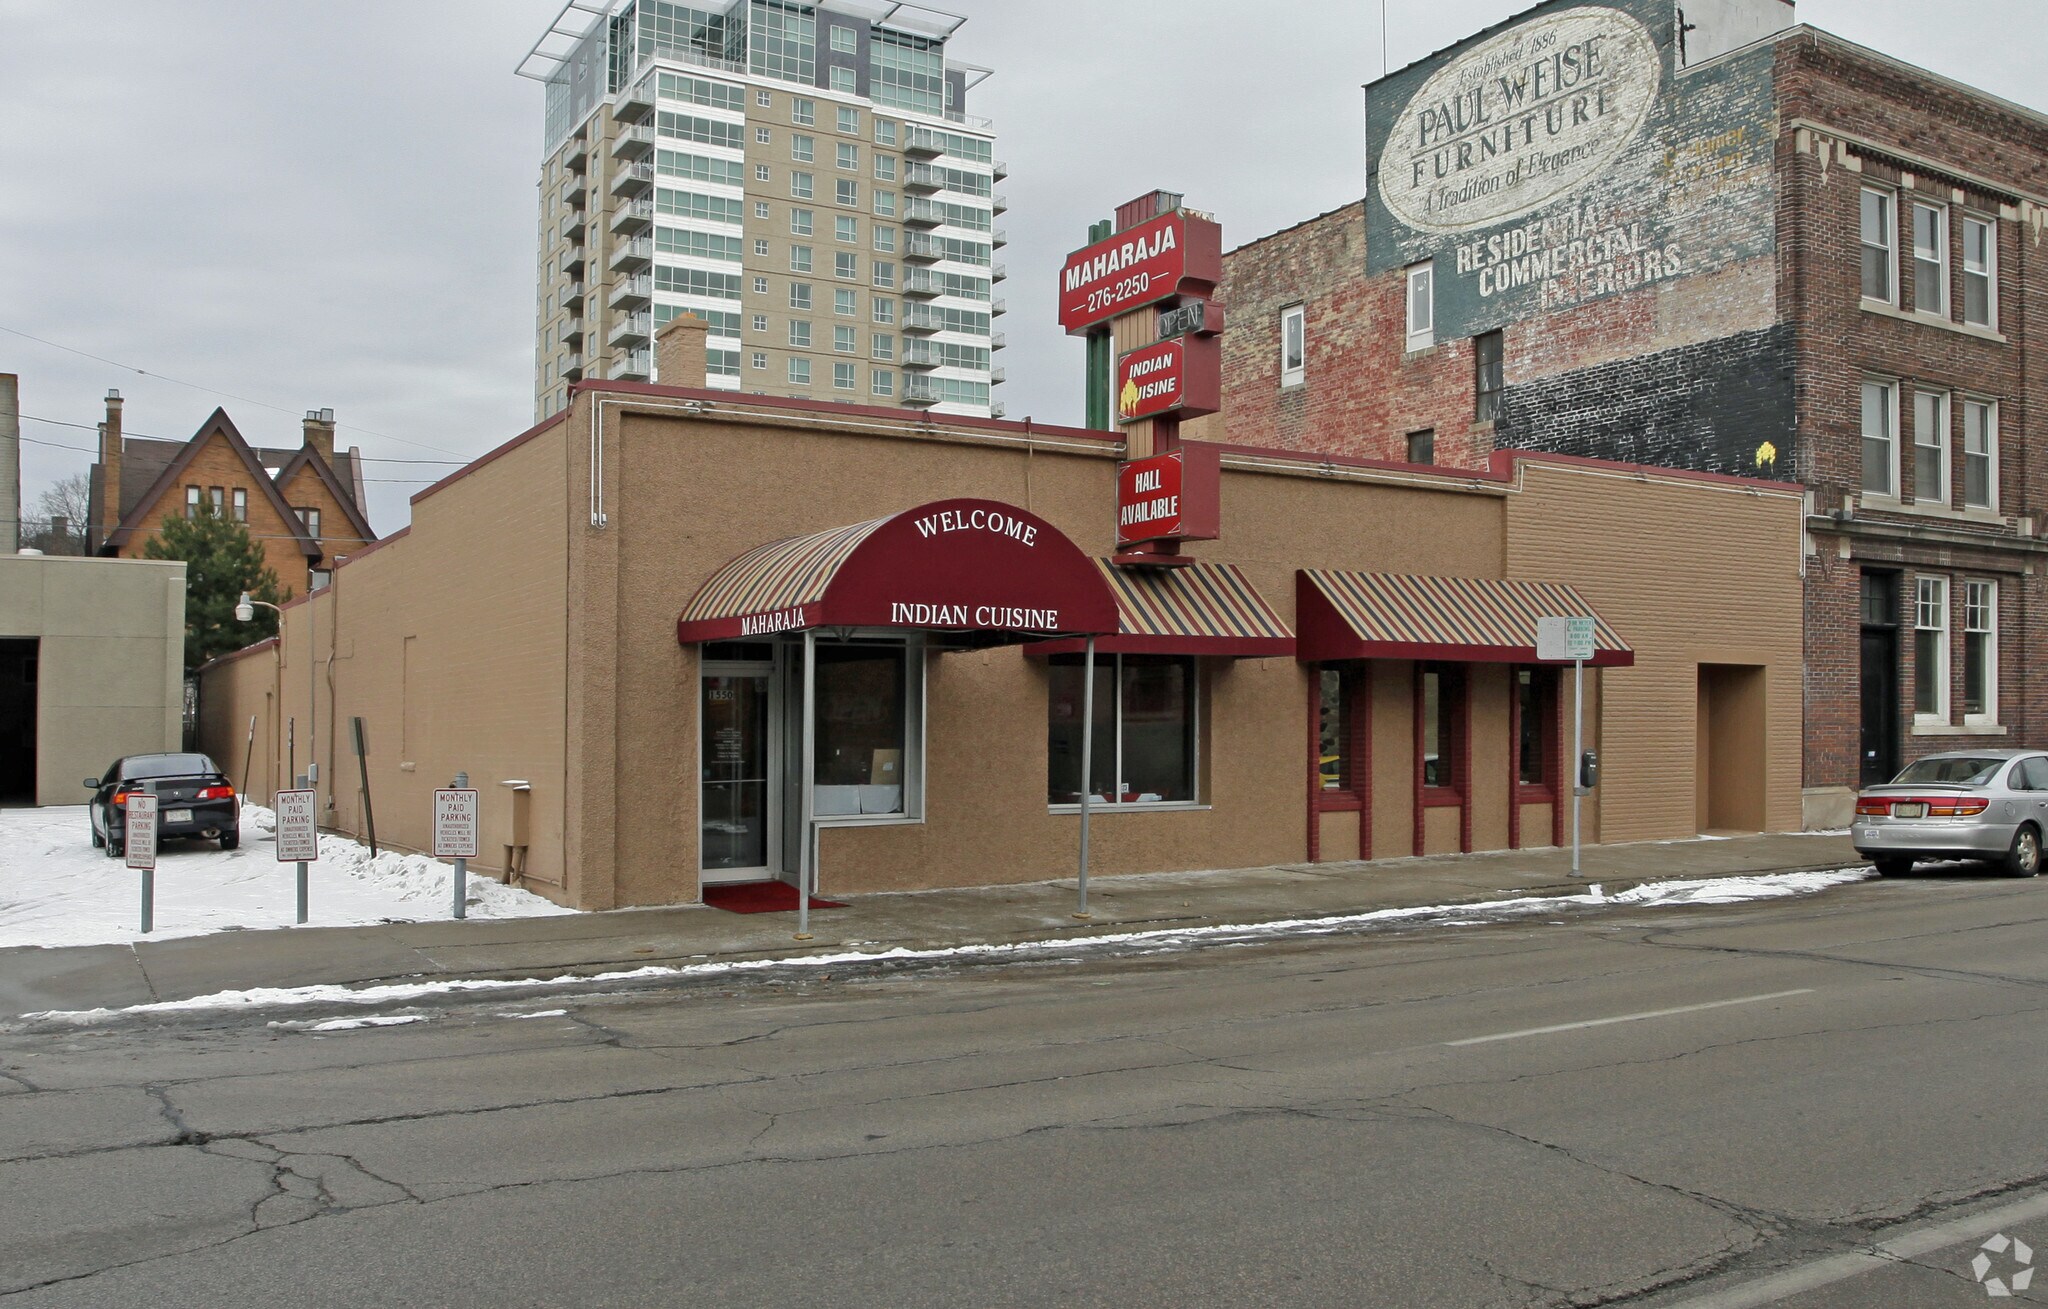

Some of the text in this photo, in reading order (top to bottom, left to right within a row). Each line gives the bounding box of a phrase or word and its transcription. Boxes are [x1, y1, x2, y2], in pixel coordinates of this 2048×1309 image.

[1457, 29, 1557, 86] Established 1886
[1417, 34, 1608, 148] PAUL WEISE
[1411, 89, 1617, 188] FURNITURE
[1438, 175, 1500, 211] Tradition
[1506, 159, 1525, 187] of
[1065, 224, 1177, 292] MAHARAJA
[1479, 222, 1648, 298] COMMERCIAL
[1087, 271, 1149, 313] 276-2250
[1159, 304, 1198, 337] OPEN
[1129, 353, 1173, 379] INDIAN
[1132, 376, 1176, 402] UISINE
[1135, 468, 1163, 494] HALL
[1121, 498, 1178, 526] AVAILABLE
[914, 508, 1038, 548] WELCOME
[741, 607, 806, 636] MAHARAJA
[891, 602, 1058, 630] INDIAN CUISINE
[710, 691, 733, 700] 1550
[137, 800, 146, 809] NO
[281, 795, 310, 804] MONTHLY
[440, 794, 472, 802] MONTHLY
[128, 811, 155, 819] RESTAURANT
[131, 822, 151, 830] PARKING
[282, 816, 310, 824] PARKING
